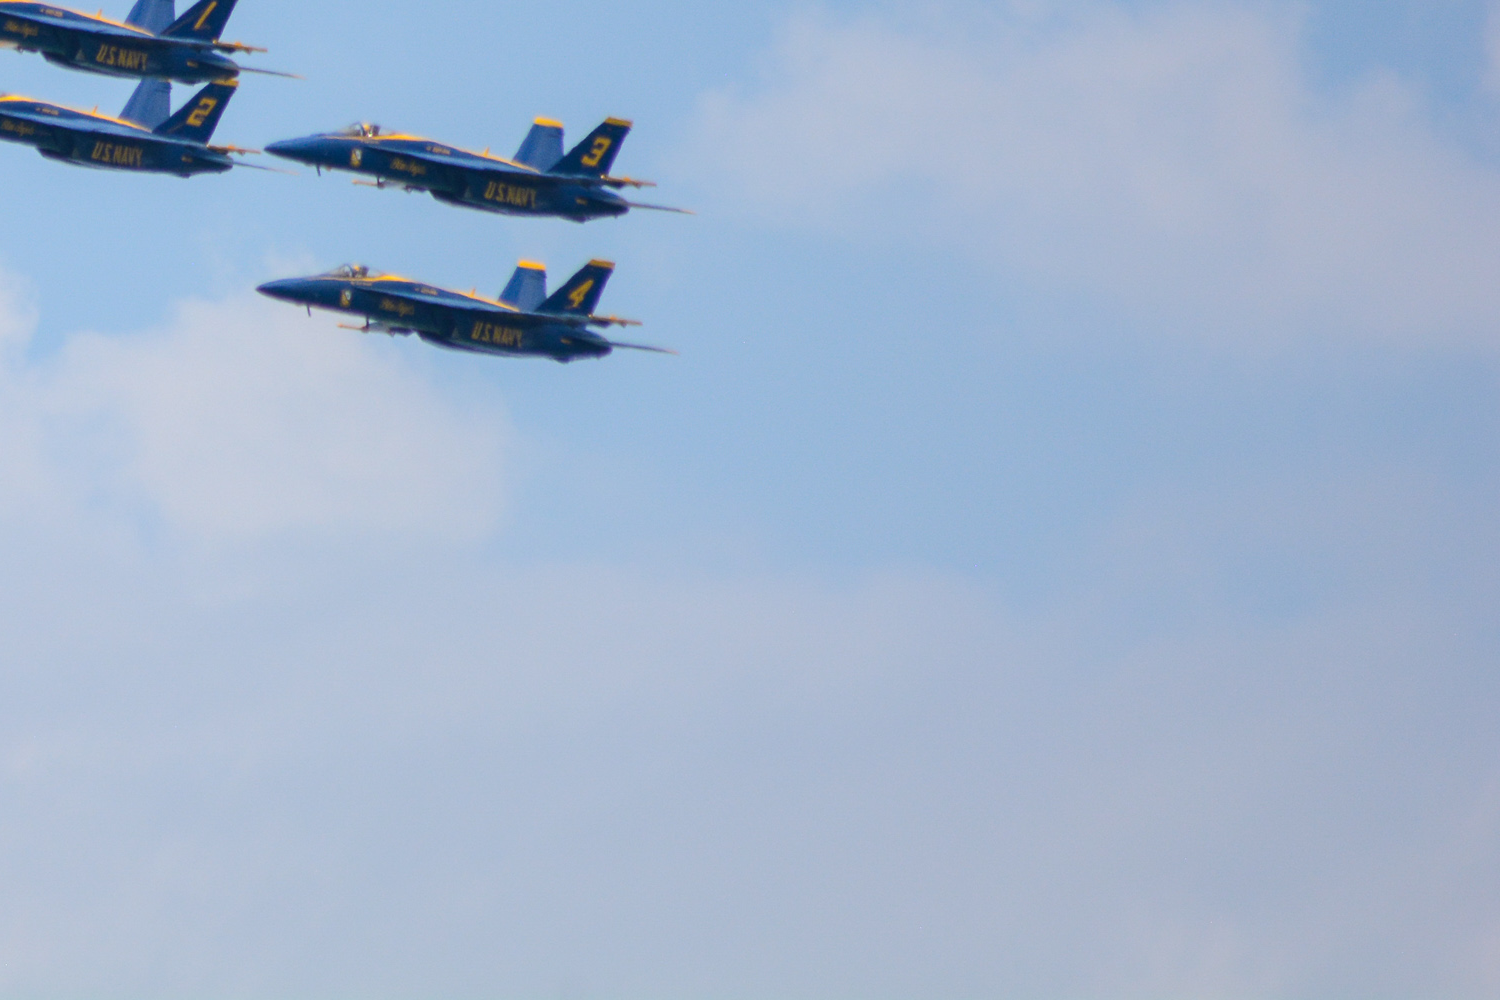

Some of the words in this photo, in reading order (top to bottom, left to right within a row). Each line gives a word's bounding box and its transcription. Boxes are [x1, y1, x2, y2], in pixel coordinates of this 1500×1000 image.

[193, 0, 217, 30] 1
[186, 97, 218, 127] 2
[581, 136, 611, 167] 3
[568, 279, 594, 309] 4
